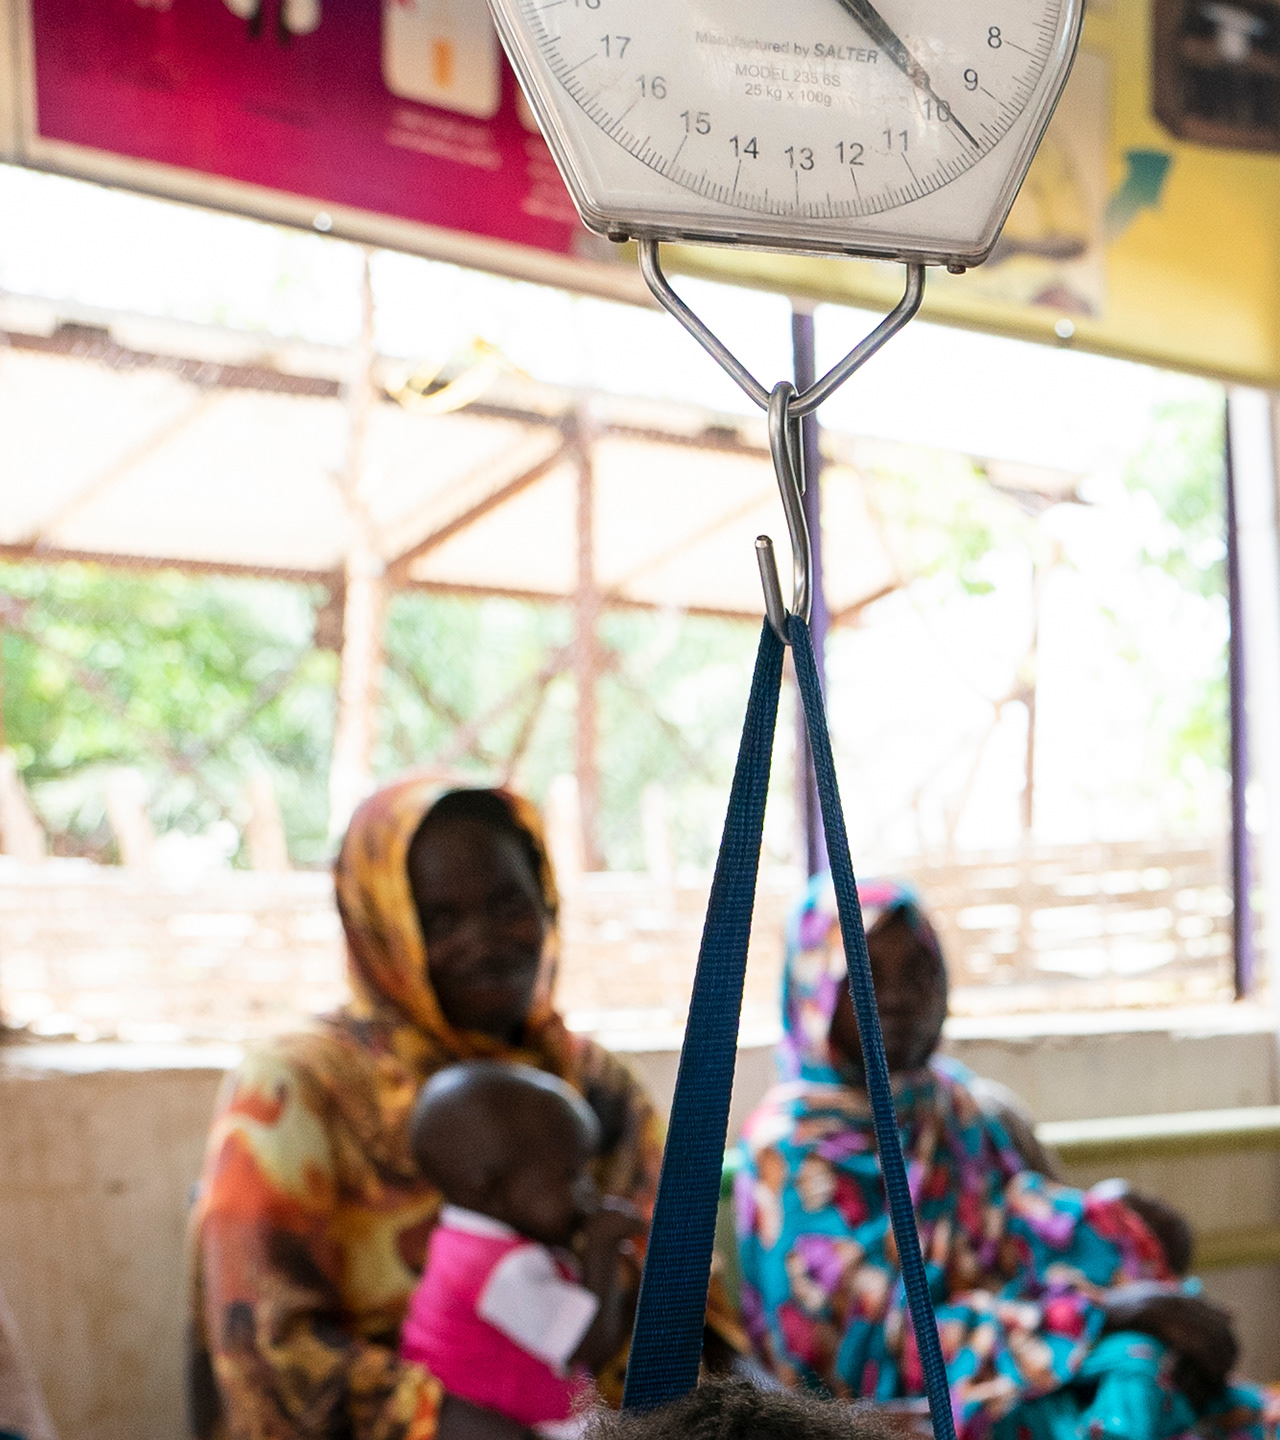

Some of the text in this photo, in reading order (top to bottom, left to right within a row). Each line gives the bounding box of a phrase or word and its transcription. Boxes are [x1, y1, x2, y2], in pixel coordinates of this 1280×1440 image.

[600, 34, 631, 59] 17
[987, 26, 1003, 49] 8
[793, 42, 810, 58] by
[813, 42, 879, 64] SALTER
[735, 63, 790, 82] MODEL
[793, 70, 818, 85] 235
[963, 68, 979, 91] 9
[636, 74, 667, 100] 16
[744, 83, 762, 97] 25
[766, 85, 782, 101] kg
[680, 110, 711, 135] 15
[924, 98, 951, 123] 10
[729, 135, 760, 159] 14
[882, 128, 909, 152] 11
[784, 146, 815, 171] 13
[835, 141, 865, 166] 12
